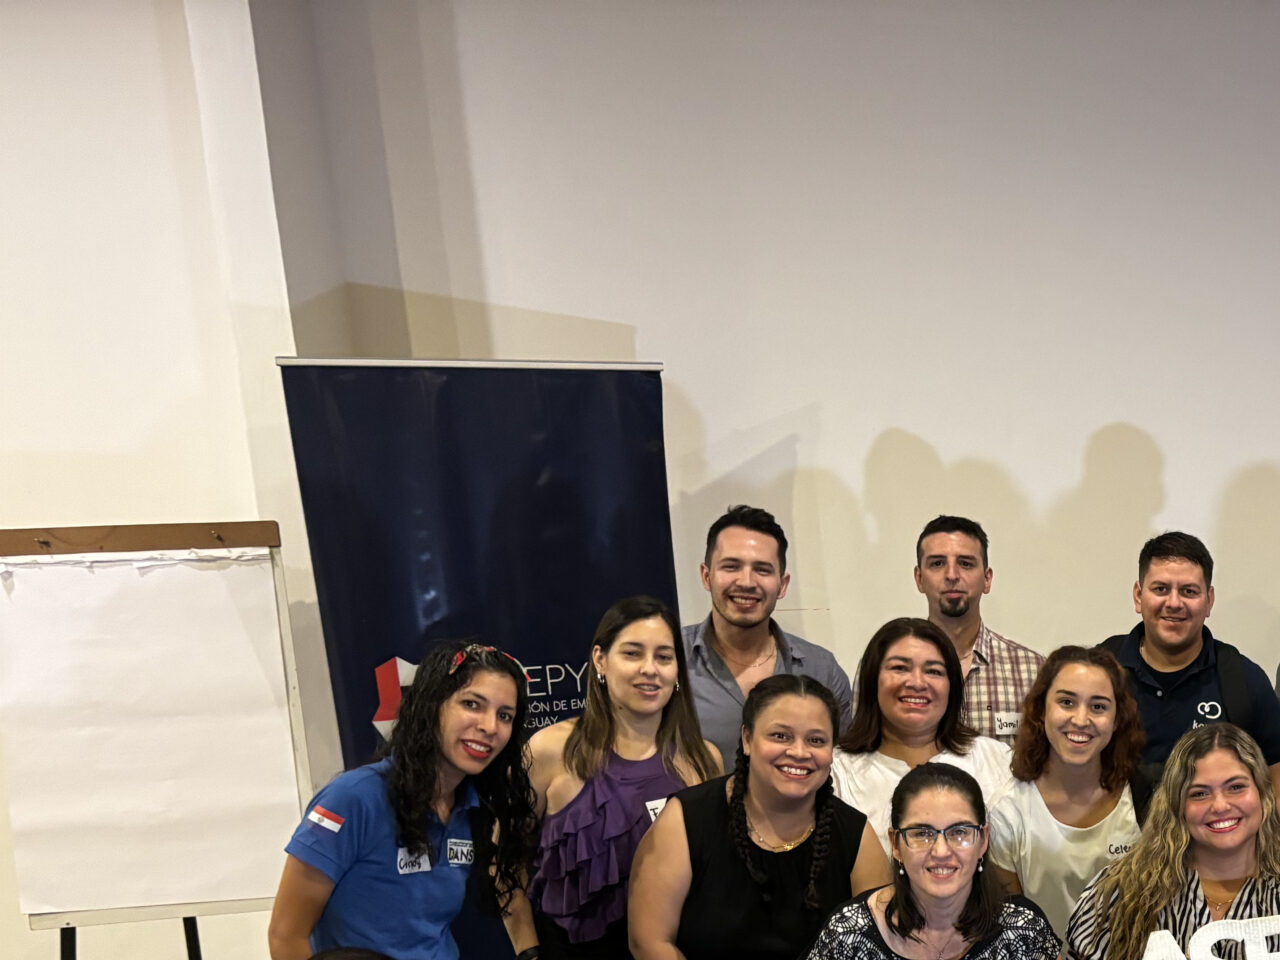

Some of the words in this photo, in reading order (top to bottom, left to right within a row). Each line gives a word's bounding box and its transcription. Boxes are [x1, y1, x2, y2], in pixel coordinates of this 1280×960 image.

[553, 700, 568, 711] DE
[571, 698, 588, 710] EM
[1108, 844, 1132, 855] Cele
